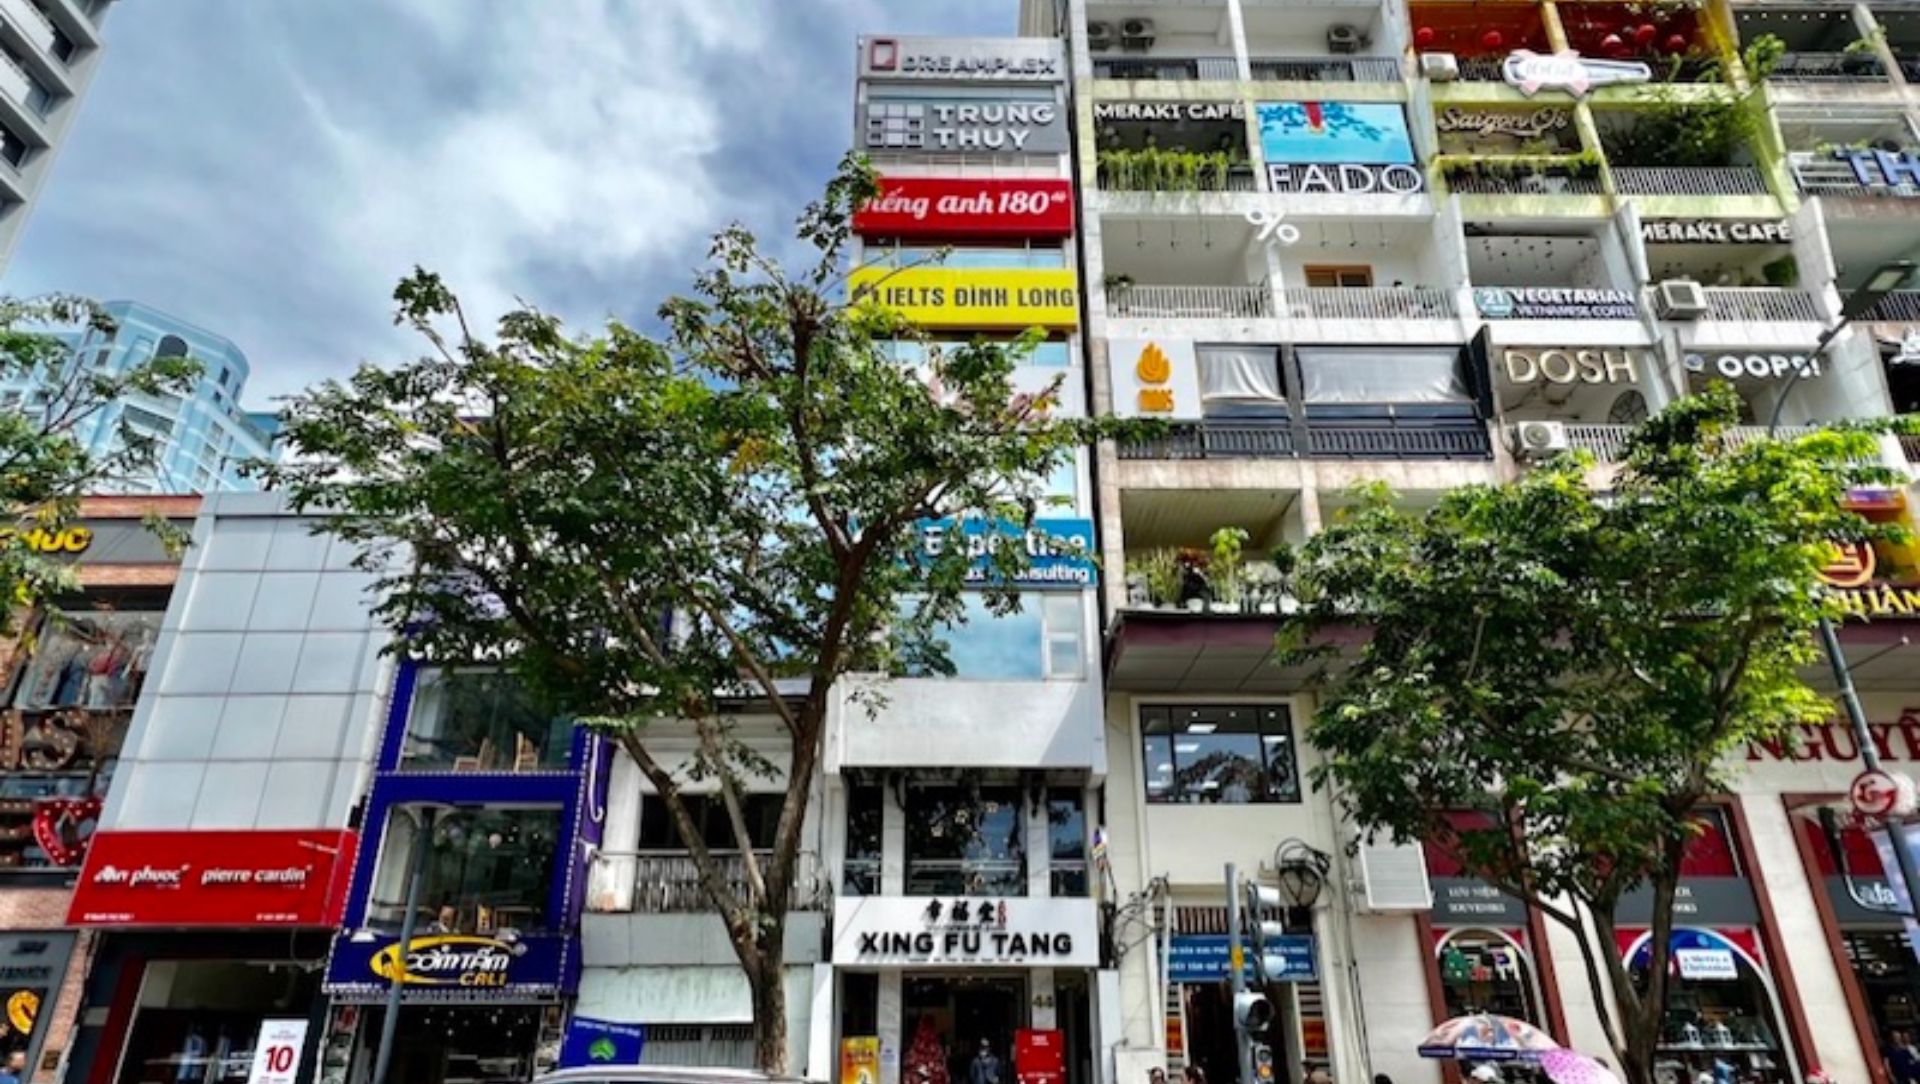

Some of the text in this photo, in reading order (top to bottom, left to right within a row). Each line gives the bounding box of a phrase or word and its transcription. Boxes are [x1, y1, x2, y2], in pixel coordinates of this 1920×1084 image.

[902, 56, 1056, 74] DREAMPLEX
[934, 104, 1055, 123] TRUNG
[1094, 99, 1244, 119] MERAKI CAFÉ
[1437, 107, 1531, 137] Saigon
[934, 128, 1029, 147] THUY
[1270, 164, 1422, 193] FADO
[937, 190, 994, 213] anh
[1639, 219, 1793, 240] MERAKI CAFÉ
[887, 287, 944, 306] IELTS
[1018, 288, 1075, 306] LONG
[1511, 289, 1634, 303] VEGETARIAN
[1504, 350, 1638, 384] DOSH
[1717, 355, 1821, 377] OOPS!
[201, 864, 306, 885] pierre cardin
[858, 931, 1072, 956] XING FU TANG
[459, 972, 507, 986] CALI
[266, 1045, 294, 1072] 10
